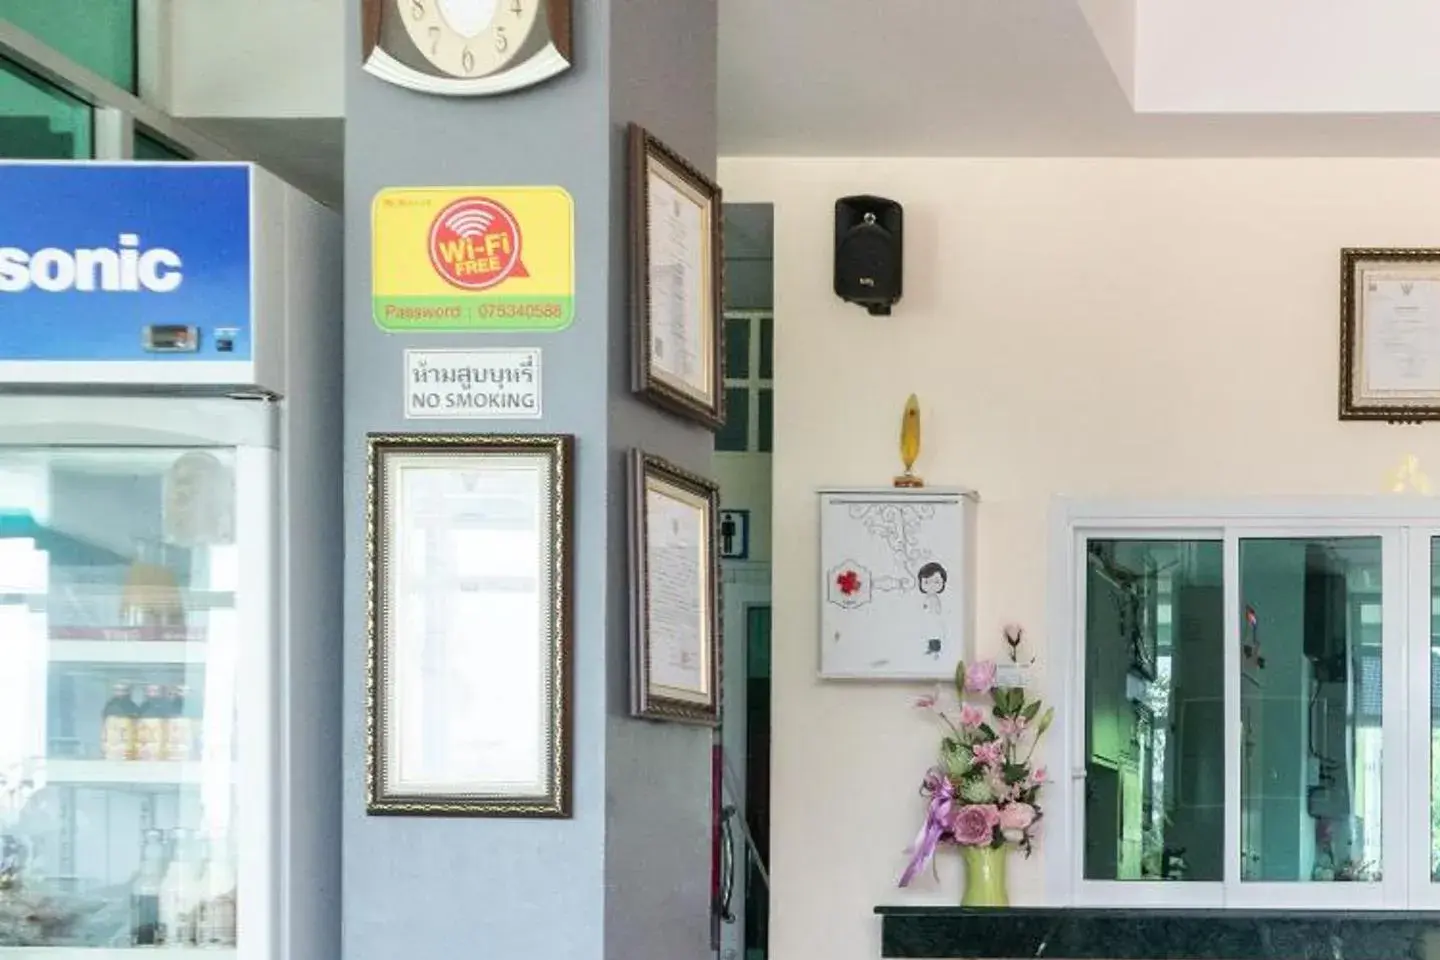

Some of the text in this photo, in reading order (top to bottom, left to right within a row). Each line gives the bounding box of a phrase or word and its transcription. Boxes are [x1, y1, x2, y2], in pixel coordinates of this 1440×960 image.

[428, 26, 442, 55] 7
[495, 26, 508, 52] 5
[439, 232, 511, 263] Wi-Fi
[0, 232, 184, 293] sonic
[455, 256, 502, 277] FREE
[384, 304, 461, 320] Password
[412, 354, 534, 390] ห้ามสูบบุหรี่
[411, 392, 536, 409] NO SMOKING
